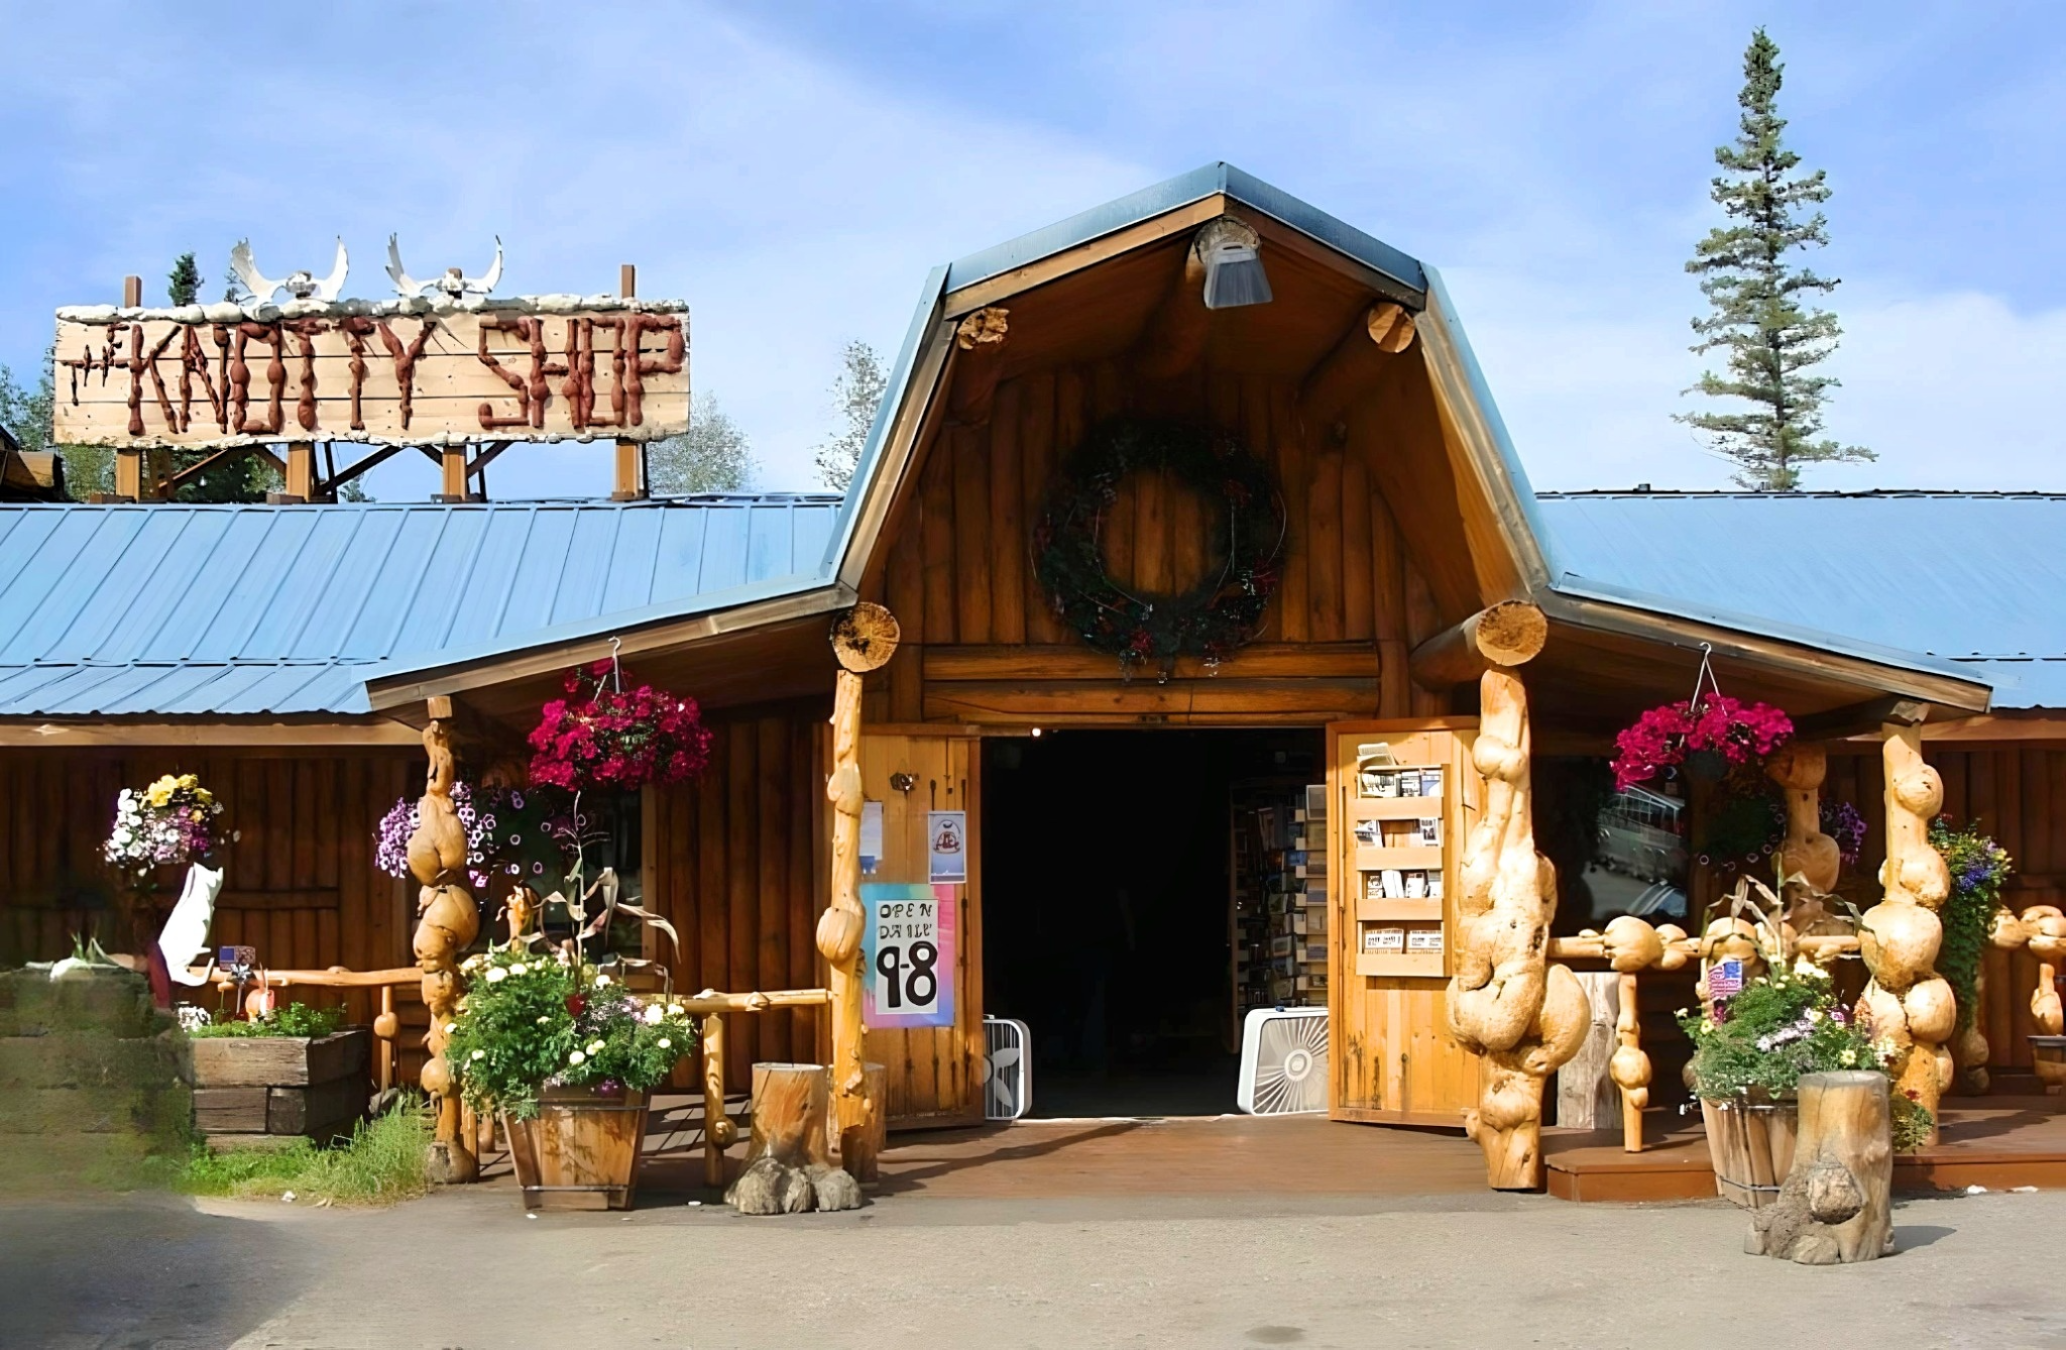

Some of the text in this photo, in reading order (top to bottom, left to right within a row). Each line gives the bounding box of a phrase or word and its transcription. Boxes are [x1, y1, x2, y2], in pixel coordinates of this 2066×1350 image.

[128, 316, 437, 436] KNOTTY
[478, 315, 686, 431] SHOP
[880, 903, 933, 919] OPEN
[876, 941, 938, 1008] 9-8
